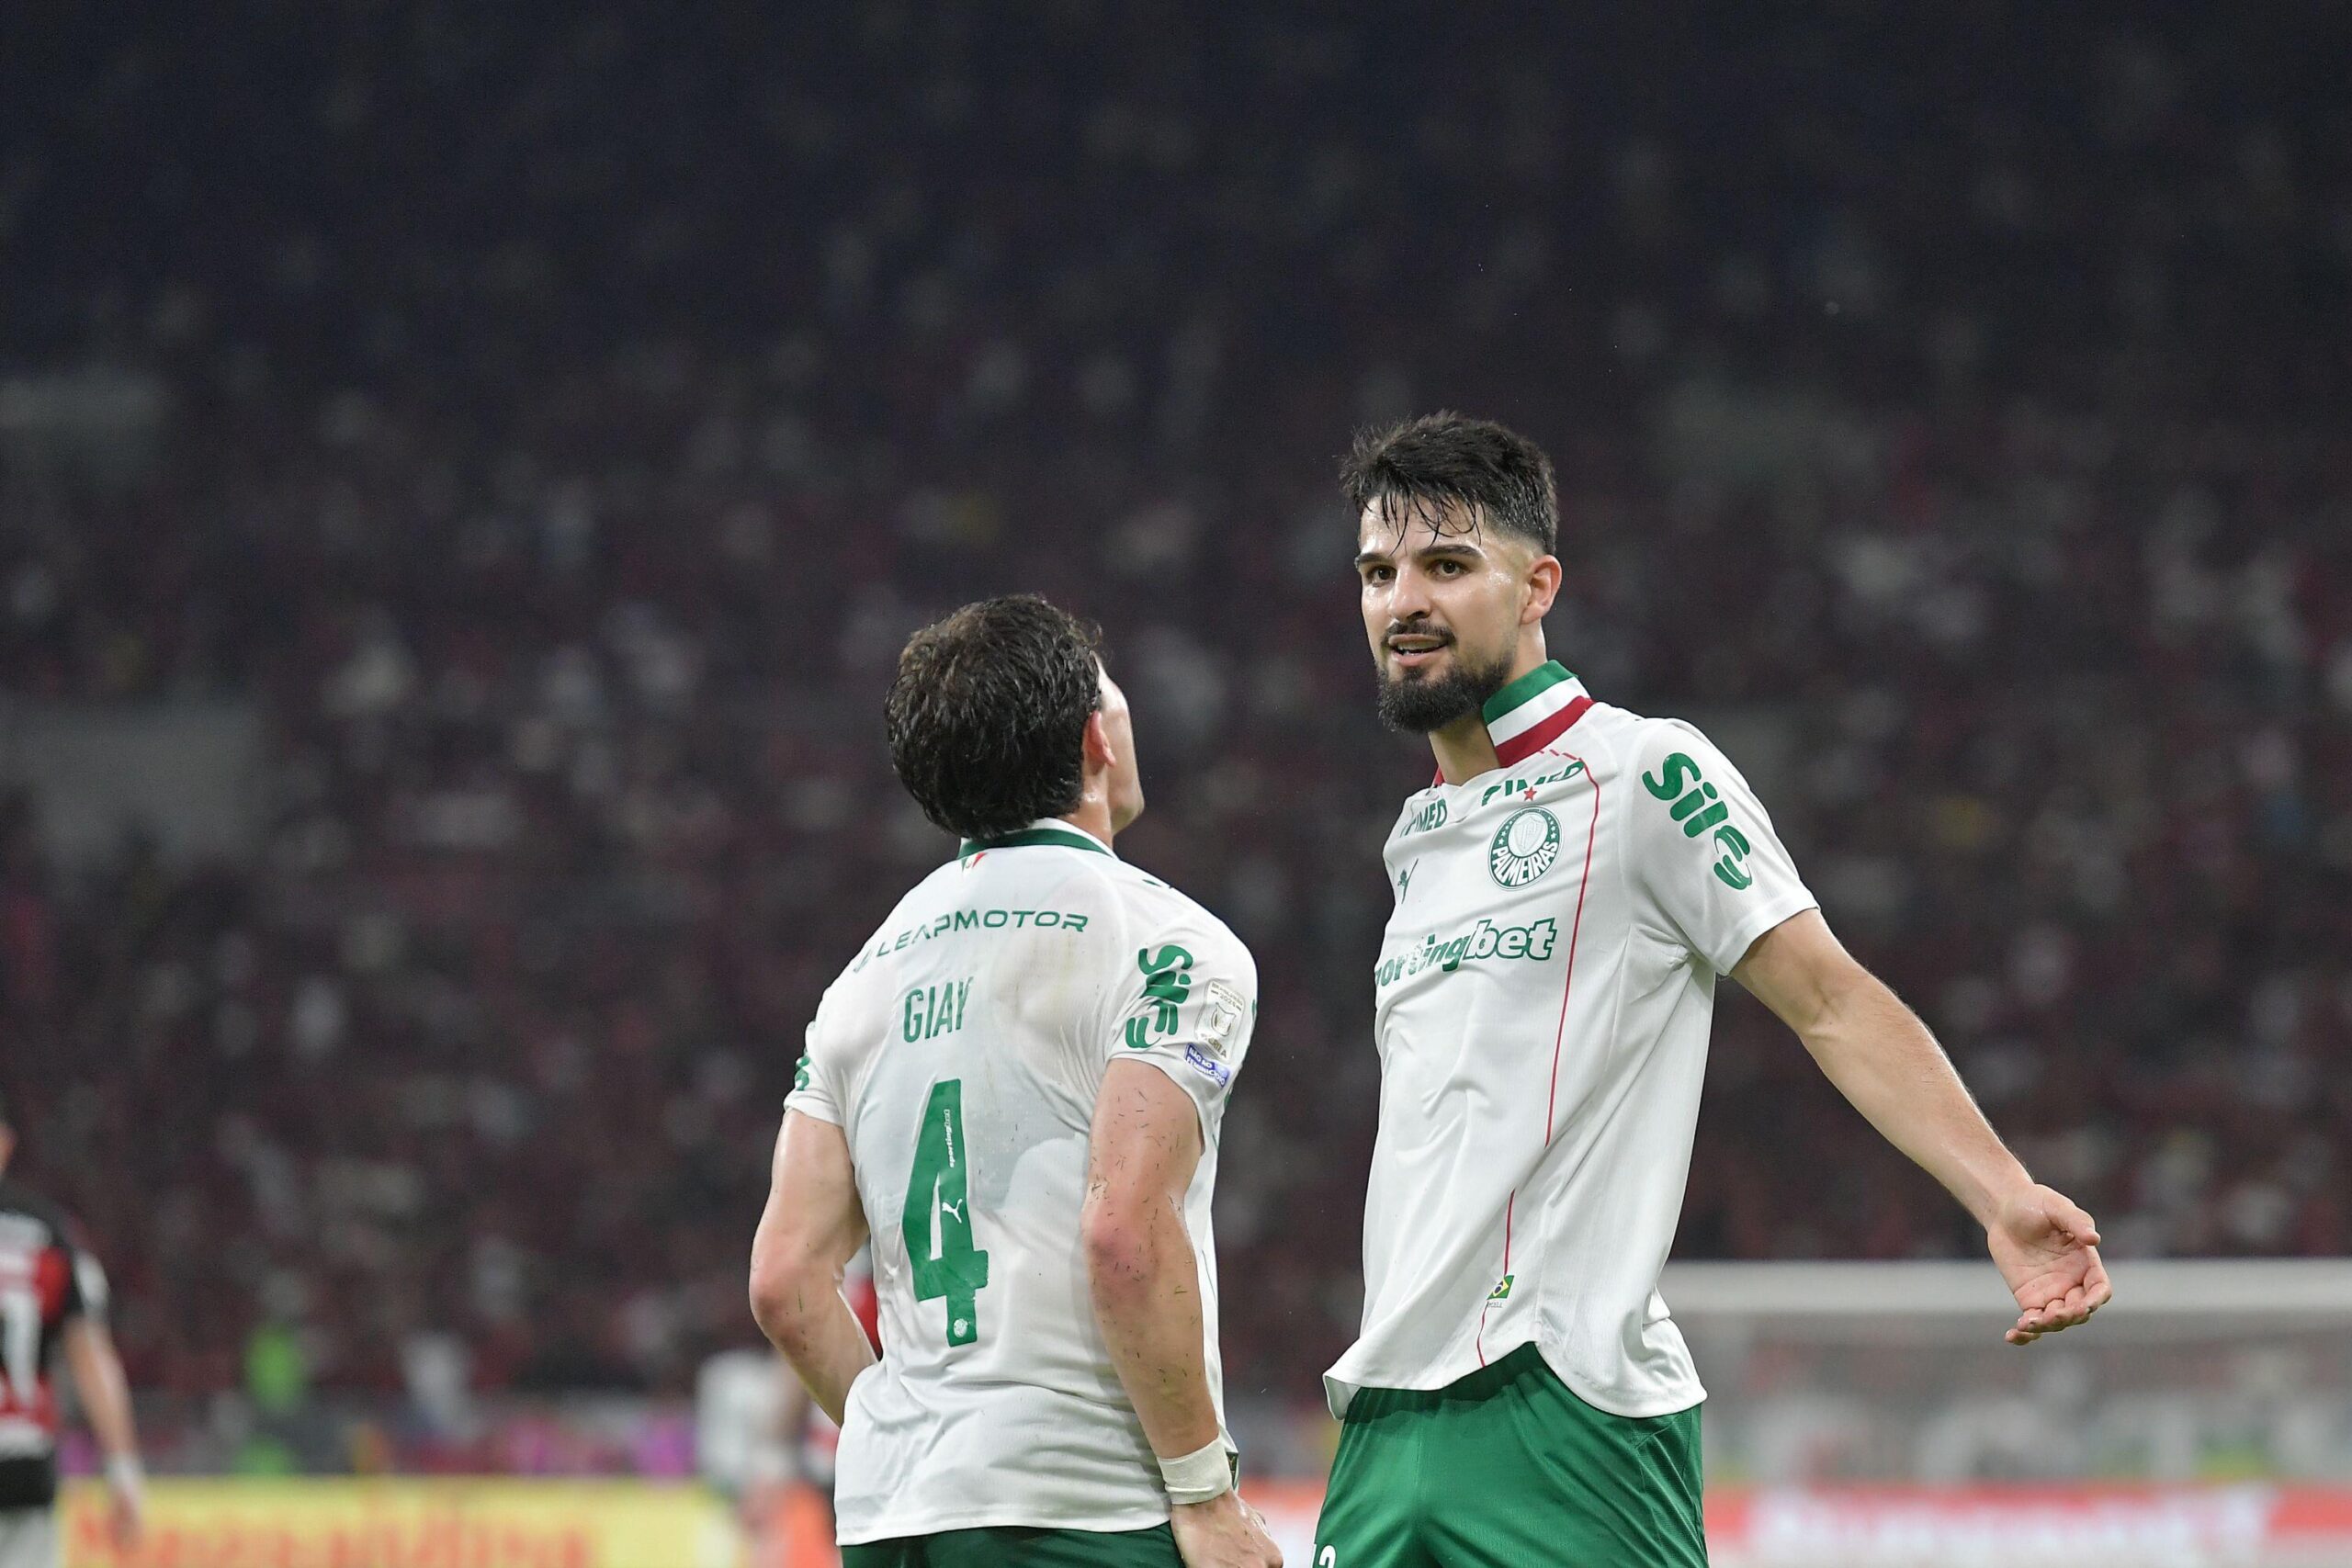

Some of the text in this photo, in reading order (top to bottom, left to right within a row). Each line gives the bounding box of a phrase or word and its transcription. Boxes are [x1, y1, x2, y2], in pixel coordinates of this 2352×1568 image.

[1491, 840, 1559, 886] PALMEIRAS
[876, 908, 1090, 957] LEAPMOTOR
[903, 976, 974, 1043] GIAY
[902, 1078, 989, 1347] 4
